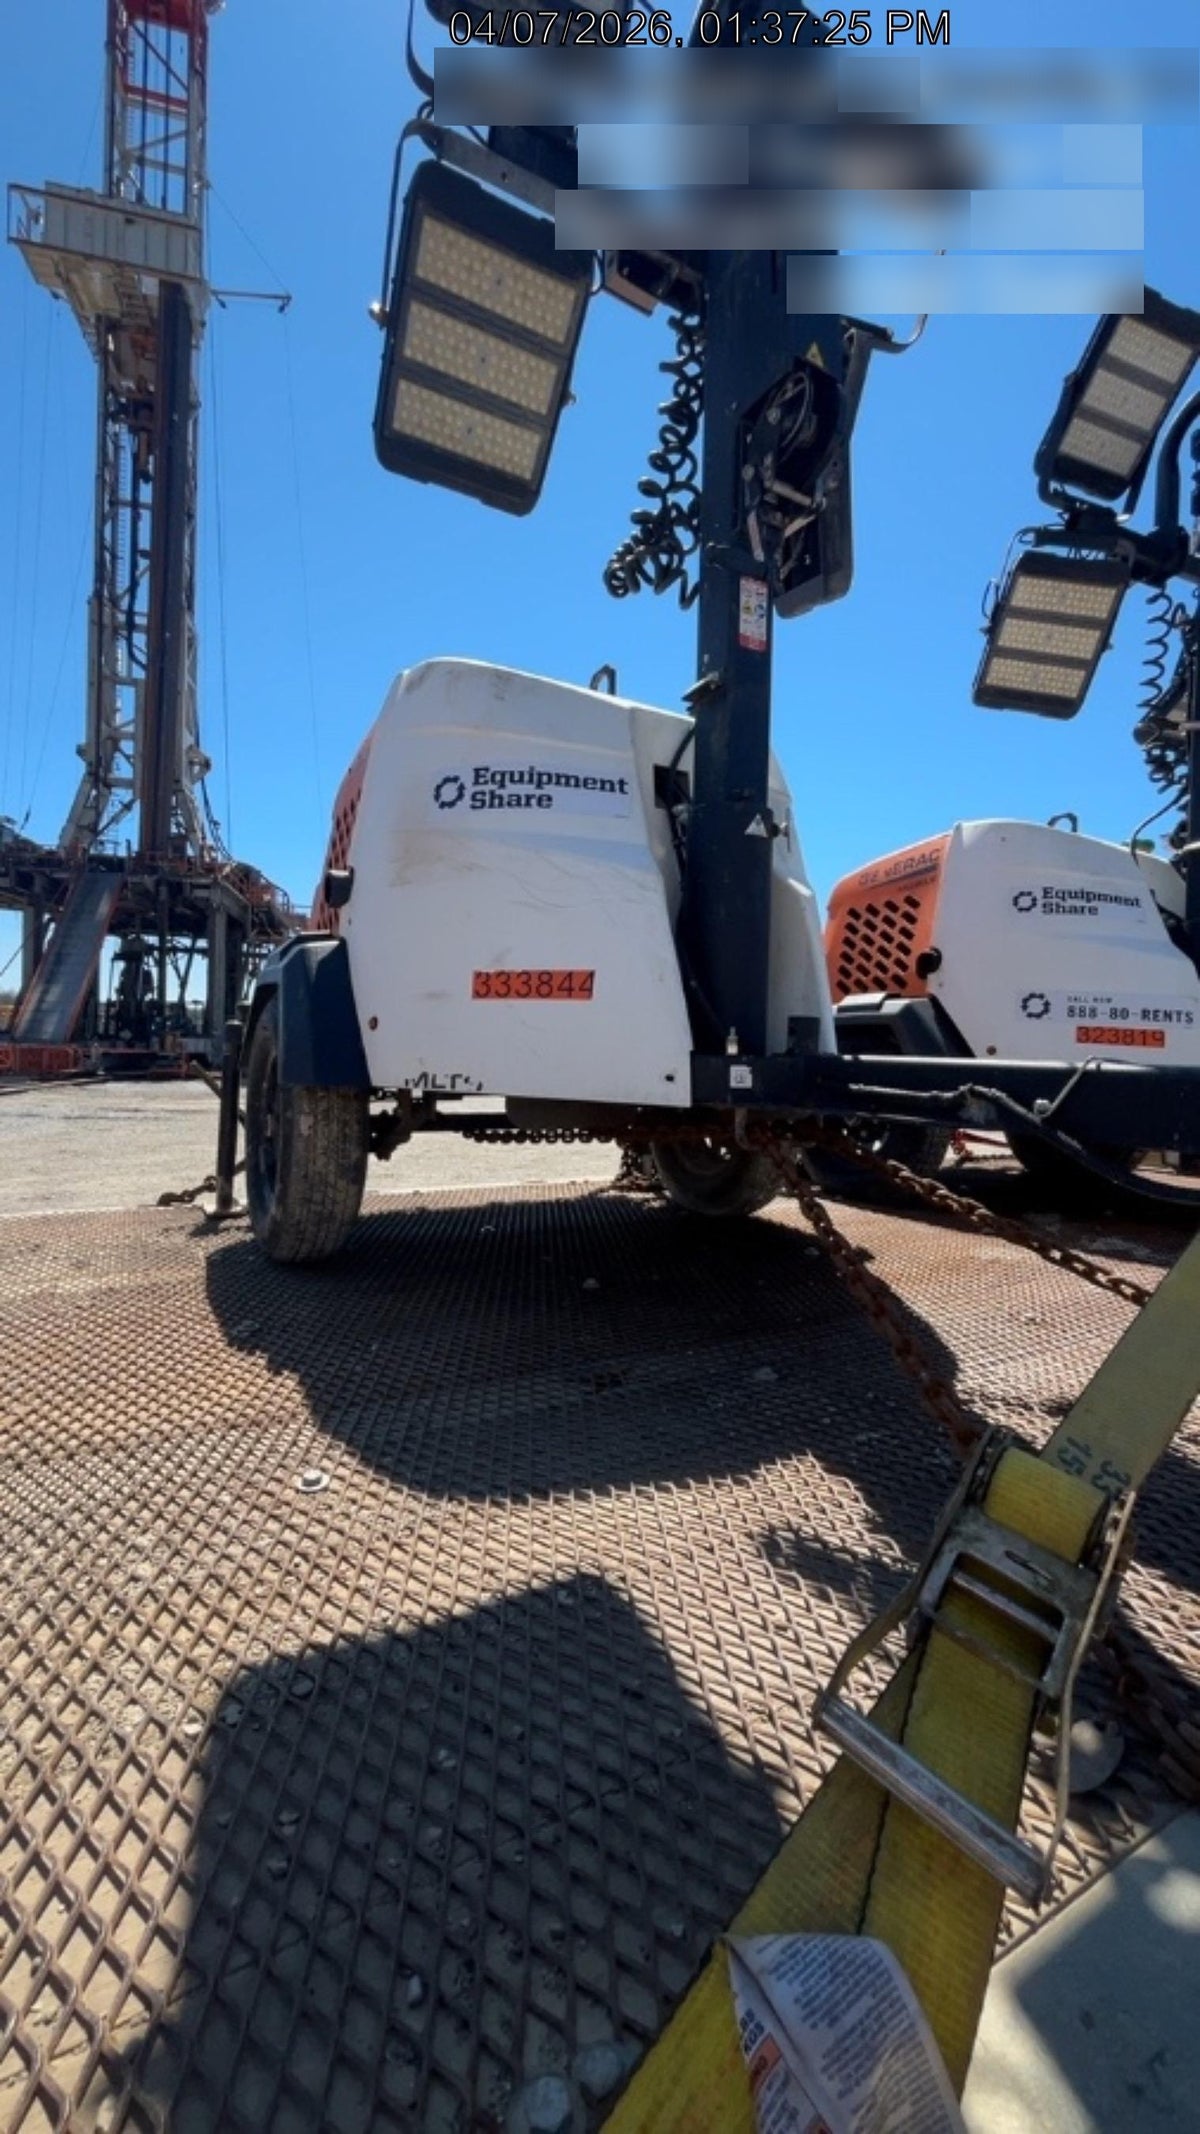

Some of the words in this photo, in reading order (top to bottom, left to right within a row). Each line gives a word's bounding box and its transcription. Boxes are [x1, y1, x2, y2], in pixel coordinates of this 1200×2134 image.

[472, 766, 629, 795] Equipment
[469, 789, 554, 810] Share
[1041, 886, 1142, 909] Equipment
[1041, 901, 1099, 916] Share
[474, 970, 595, 999] 333844
[1066, 1005, 1195, 1025] 888-80-RENTS
[1076, 1026, 1165, 1048] 323819
